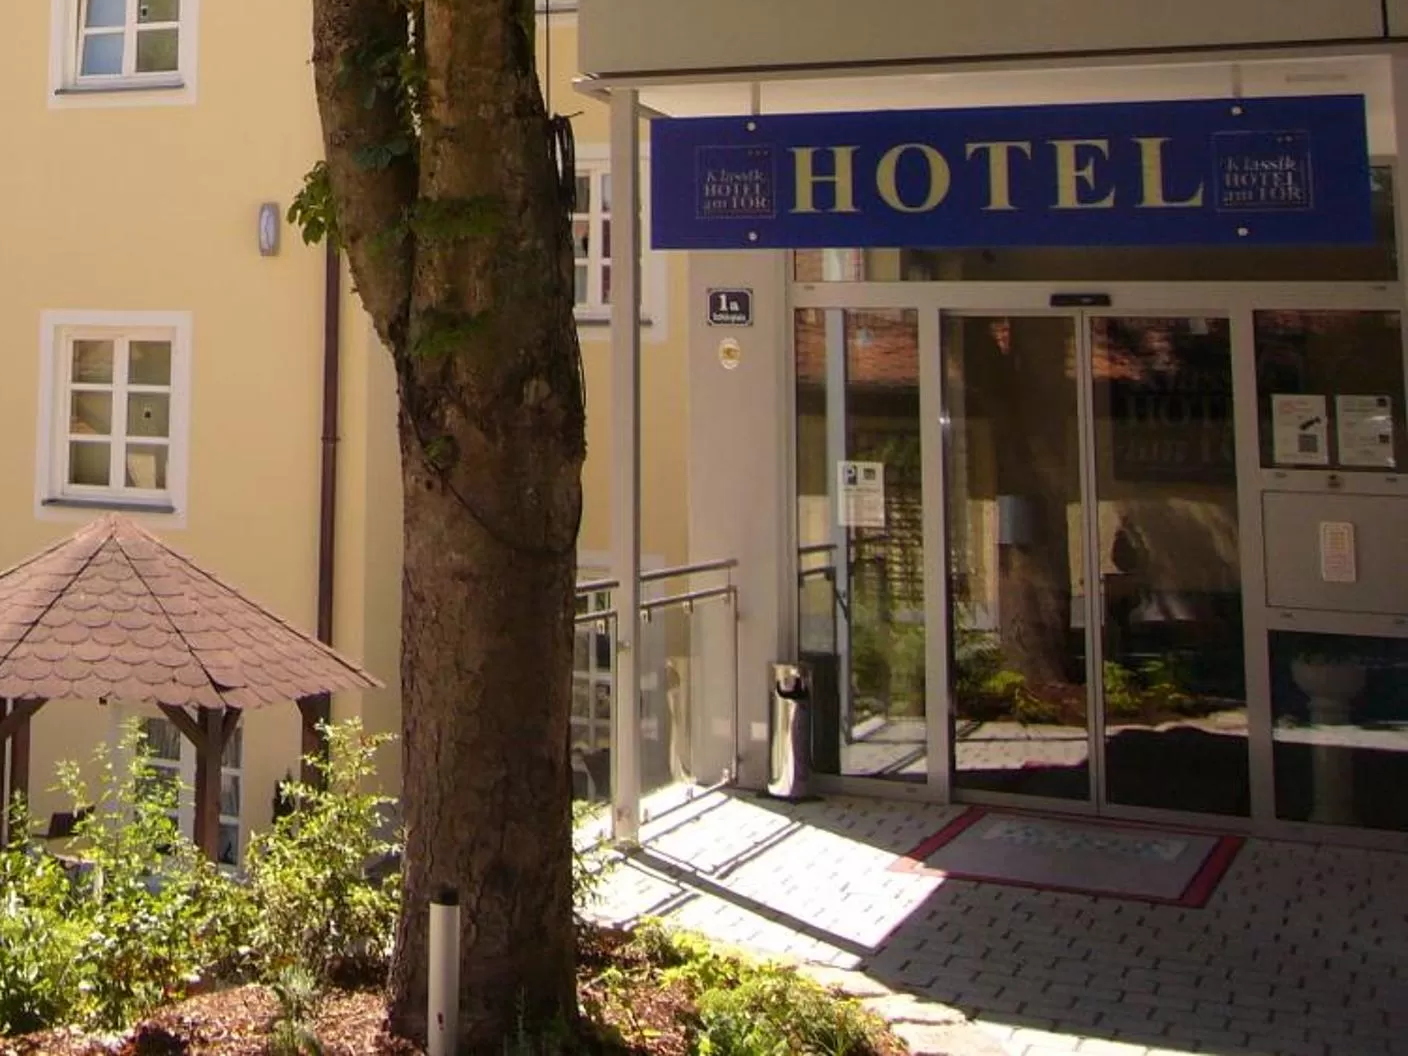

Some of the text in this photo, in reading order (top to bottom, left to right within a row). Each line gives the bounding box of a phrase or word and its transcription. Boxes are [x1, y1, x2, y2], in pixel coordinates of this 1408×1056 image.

[788, 137, 1204, 213] HOTEL
[1224, 171, 1300, 187] HOTEL
[704, 183, 769, 198] HOTEL
[1260, 186, 1302, 202] TOR
